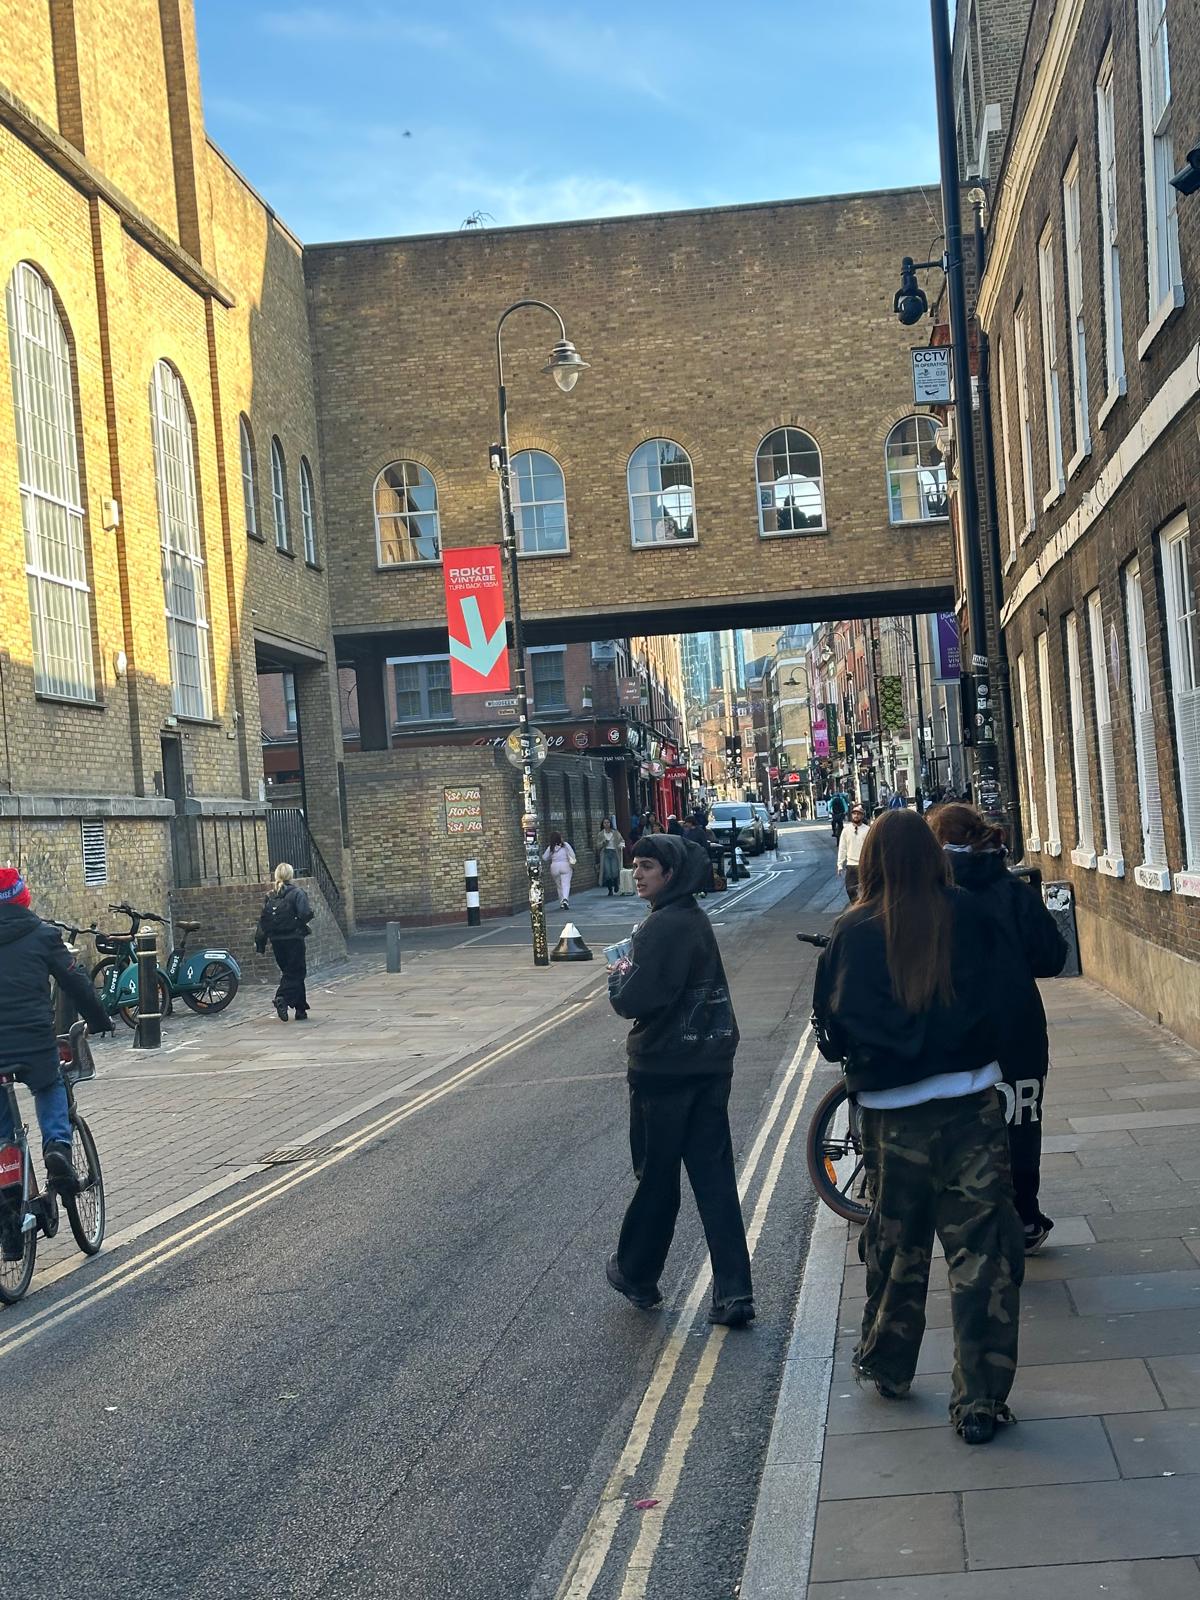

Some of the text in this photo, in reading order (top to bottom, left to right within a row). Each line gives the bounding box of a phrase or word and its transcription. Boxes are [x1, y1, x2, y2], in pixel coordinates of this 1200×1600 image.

[914, 352, 946, 362] CCTV
[449, 566, 495, 577] ROKIT
[451, 574, 496, 584] VINTAGE
[448, 806, 480, 817] florist
[109, 970, 119, 993] forest
